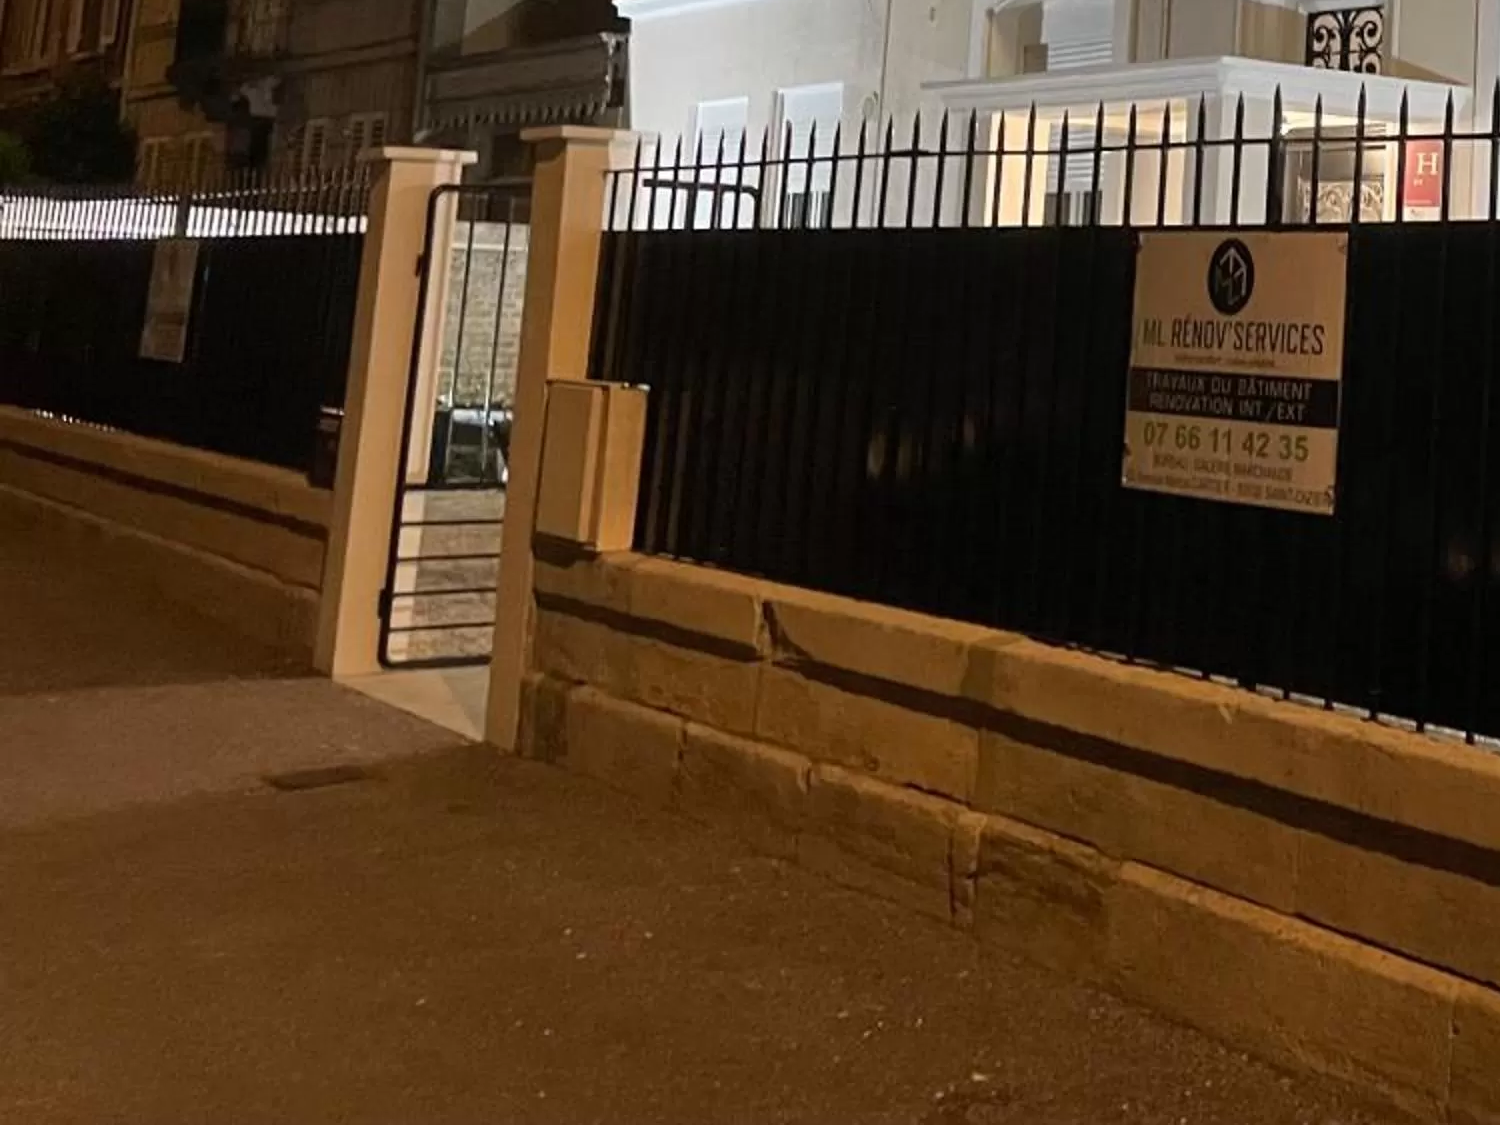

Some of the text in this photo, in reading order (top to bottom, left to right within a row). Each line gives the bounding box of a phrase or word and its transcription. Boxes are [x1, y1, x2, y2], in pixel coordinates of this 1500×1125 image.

[1416, 151, 1439, 176] H
[1142, 317, 1165, 348] ML
[1147, 371, 1205, 394] TRAVAUX
[1211, 376, 1232, 395] DU
[1143, 422, 1310, 463] 07 66 11 42 35
